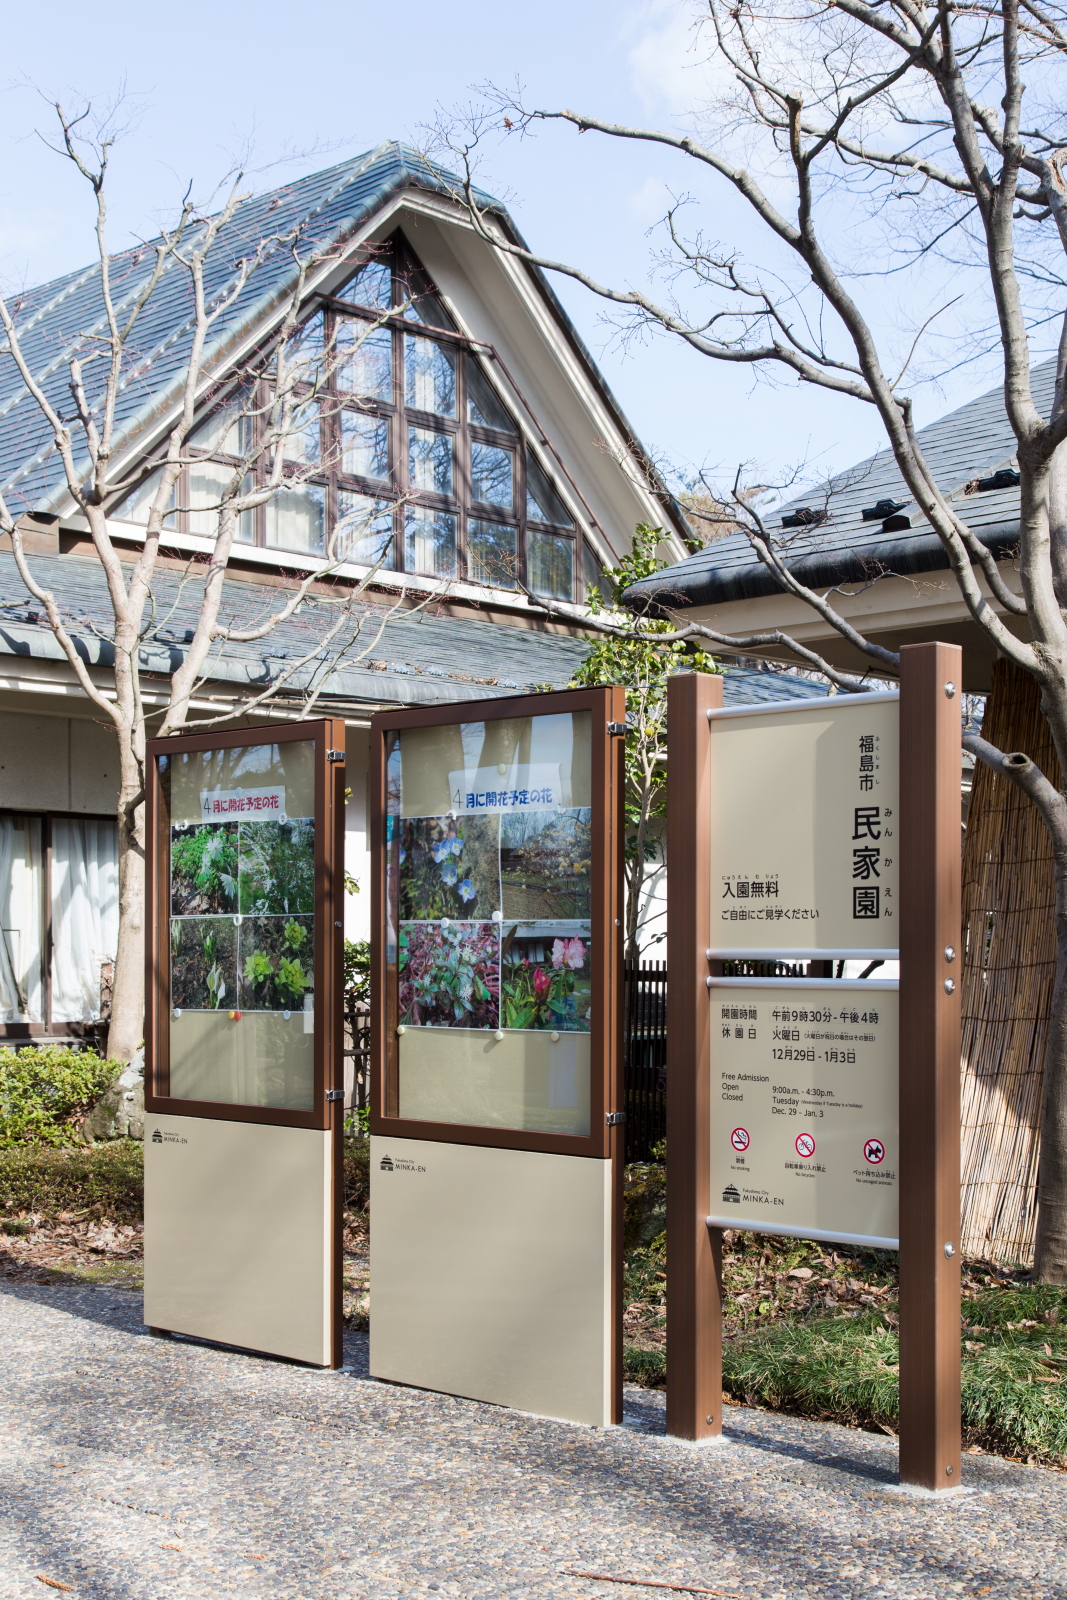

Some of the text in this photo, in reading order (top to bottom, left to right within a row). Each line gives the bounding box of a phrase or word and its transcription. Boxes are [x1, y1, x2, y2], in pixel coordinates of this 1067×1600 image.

[859, 735, 874, 791] 福島市
[203, 795, 279, 814] 4月に開花予定の花
[452, 788, 553, 809] 4月に開花予定の花
[852, 806, 881, 919] 民家園
[884, 808, 892, 916] みんかえん
[722, 881, 779, 898] 入園無料
[722, 909, 820, 920] ご自由にご見学ください
[722, 1008, 757, 1020] 開園時間
[722, 1027, 756, 1039] 休園日
[772, 1030, 800, 1041] 火曜日
[772, 1048, 815, 1061] 12月29日
[824, 1051, 856, 1063] 1月3日
[722, 1072, 769, 1082] Free Admission
[722, 1082, 739, 1091] Open
[772, 1086, 800, 1094] 9:00a.m.
[806, 1088, 834, 1098] 4:30p.m.
[722, 1092, 744, 1101] Closed
[772, 1096, 799, 1107] Tuesday
[772, 1106, 786, 1115] Dec.
[804, 1109, 817, 1117] Jan.
[819, 1110, 824, 1118] 3
[395, 1164, 426, 1172] MINKA-EN
[742, 1195, 784, 1205] MINKA-EN
